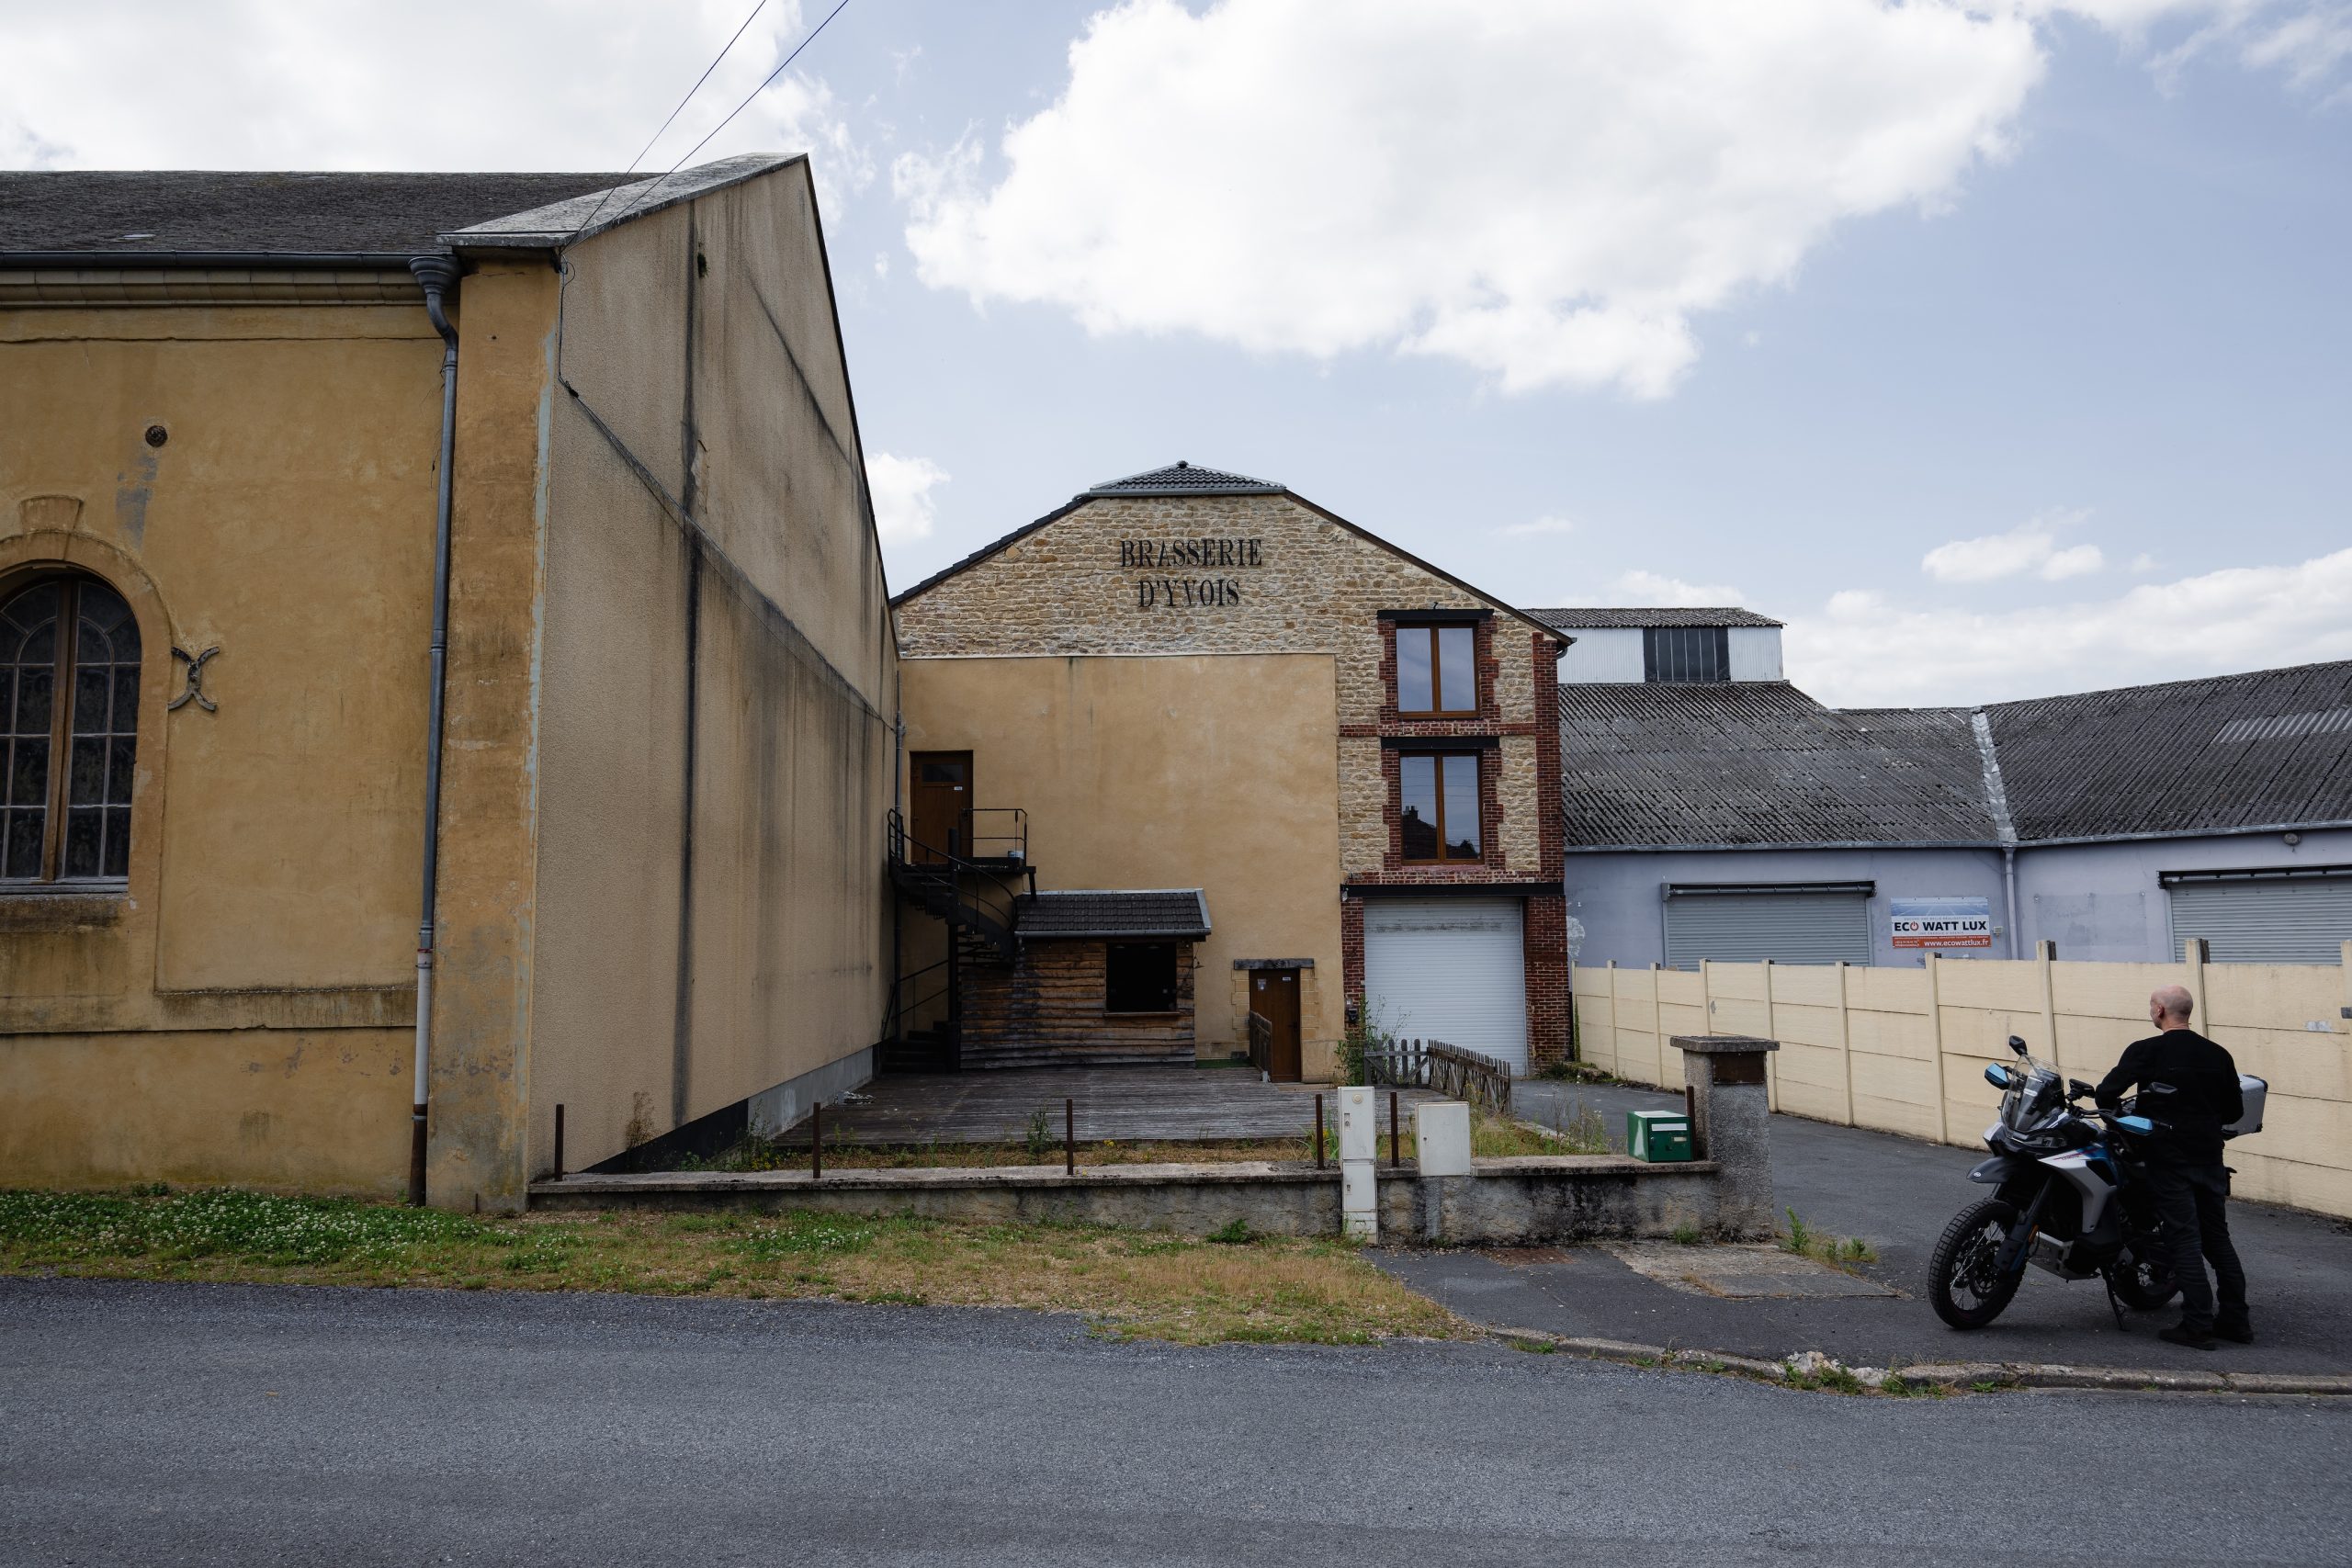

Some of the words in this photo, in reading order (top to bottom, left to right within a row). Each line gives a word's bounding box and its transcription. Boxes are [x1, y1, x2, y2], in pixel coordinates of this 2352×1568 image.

[1119, 538, 1262, 567] BRASSERIE
[1138, 579, 1239, 607] D'YVOIS
[1894, 920, 1919, 931] ECO
[1923, 920, 1959, 931] WATT
[1962, 920, 1987, 931] LUX
[1924, 939, 1989, 947] www.ecowattlux.fr
